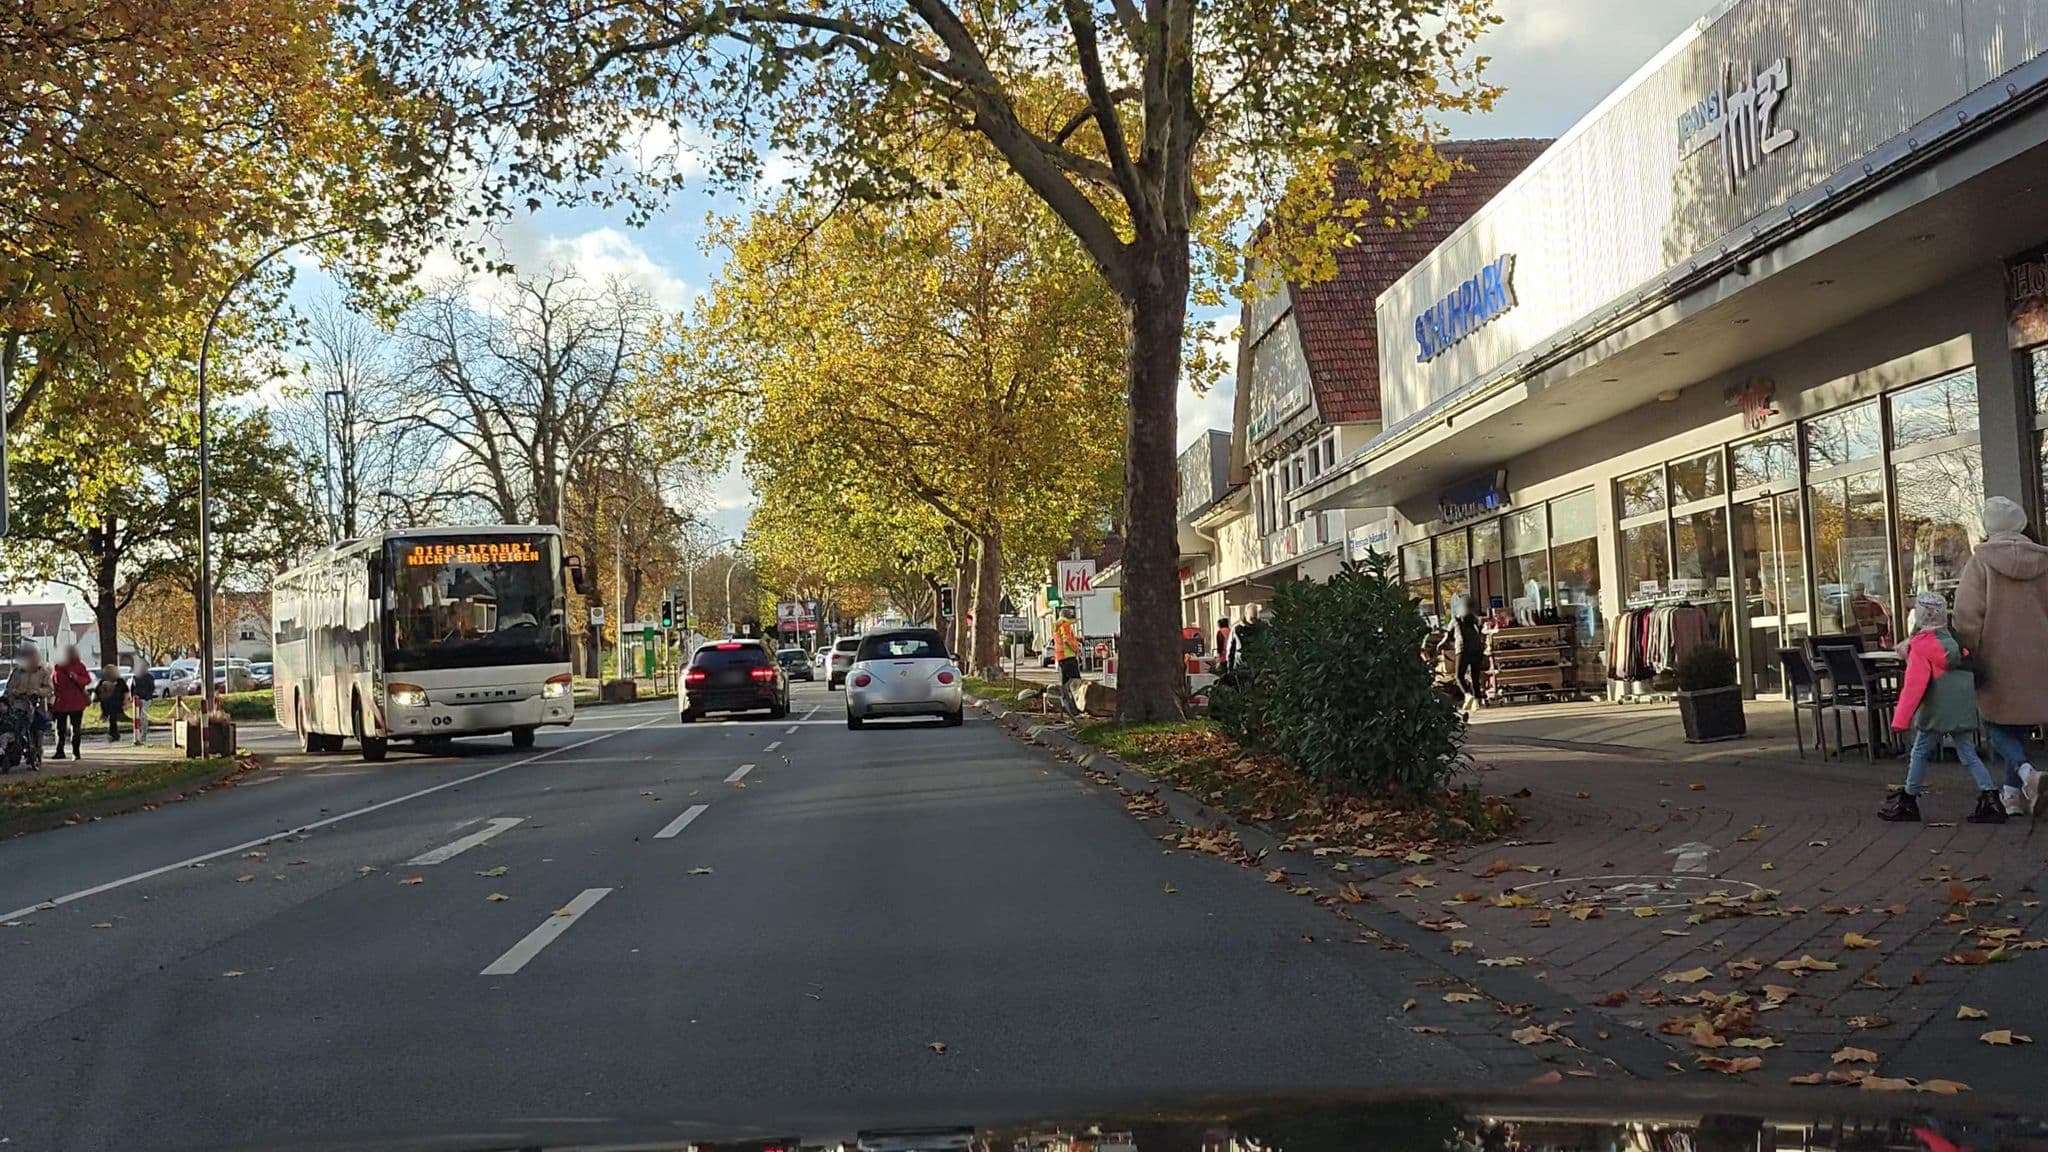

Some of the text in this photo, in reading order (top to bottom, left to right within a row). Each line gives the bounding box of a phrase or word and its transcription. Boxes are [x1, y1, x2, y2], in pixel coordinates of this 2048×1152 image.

[1415, 254, 1516, 362] SCHUHPARK
[415, 542, 532, 555] DIENSTFAHRT
[408, 551, 539, 566] NICHT EINSTEIGEN
[1065, 565, 1092, 592] kik
[456, 689, 517, 699] SETRA
